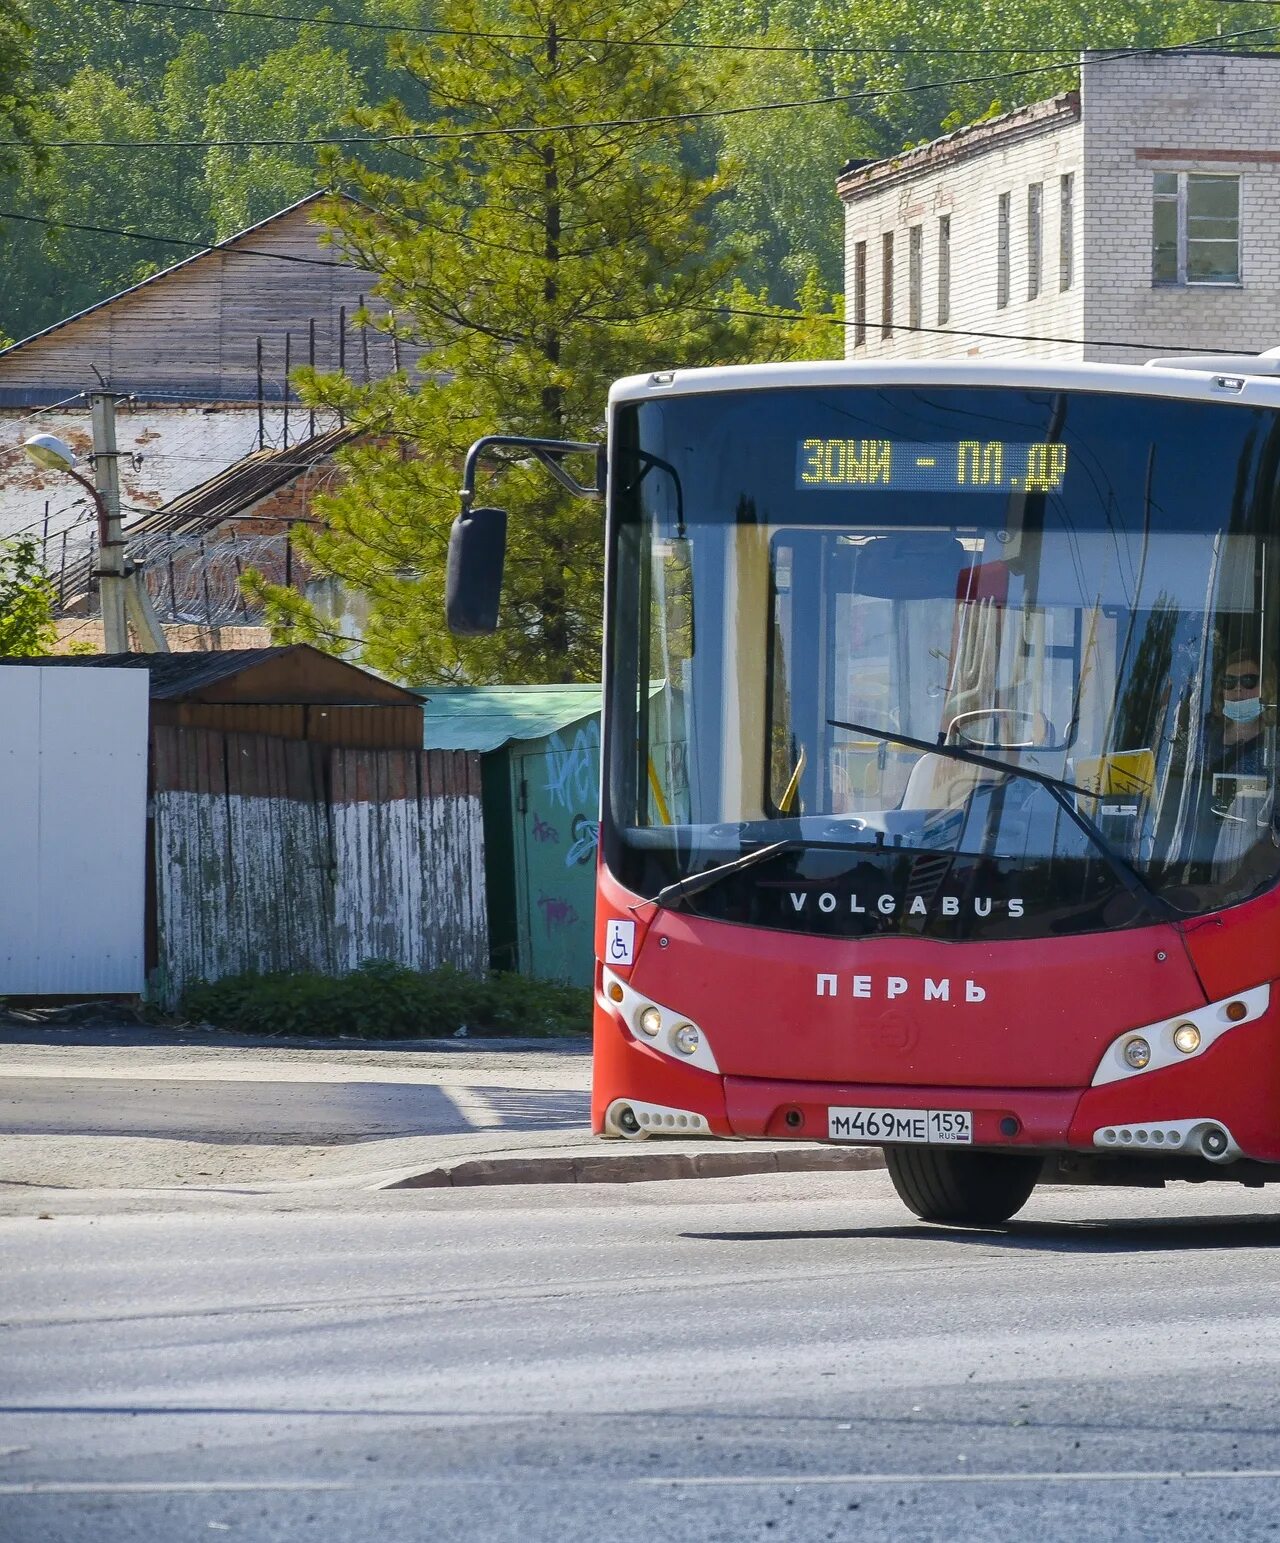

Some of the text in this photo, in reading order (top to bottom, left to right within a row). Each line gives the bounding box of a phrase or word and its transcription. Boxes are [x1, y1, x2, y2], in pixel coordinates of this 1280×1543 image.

[790, 892, 1025, 918] VOLGABUS
[816, 973, 986, 1003] ПЕРМЬ
[931, 1113, 965, 1133] 159
[938, 1132, 956, 1140] RUS
